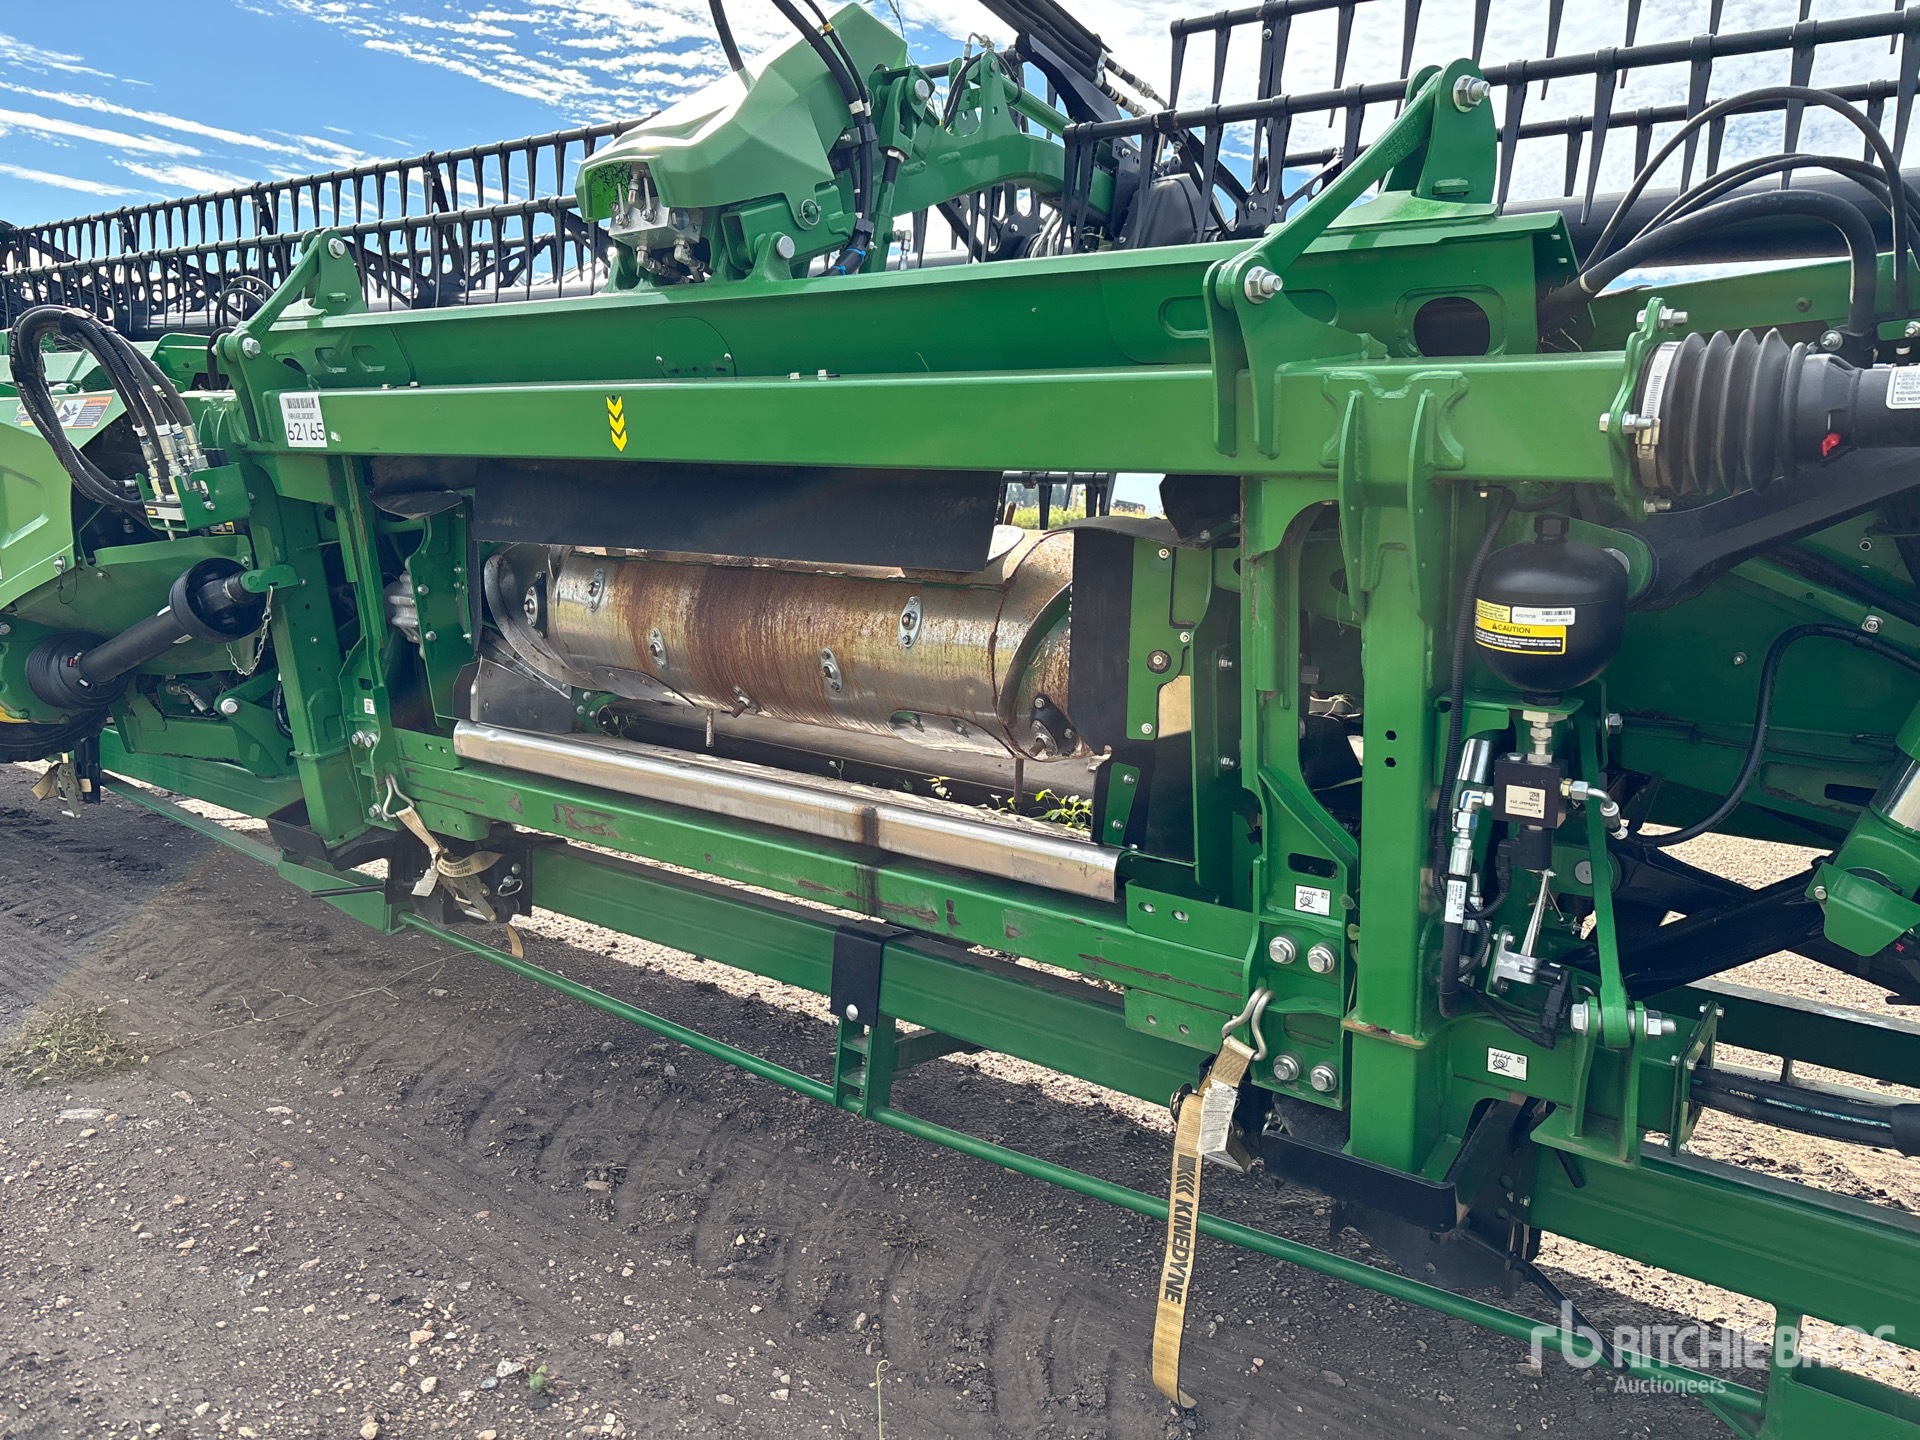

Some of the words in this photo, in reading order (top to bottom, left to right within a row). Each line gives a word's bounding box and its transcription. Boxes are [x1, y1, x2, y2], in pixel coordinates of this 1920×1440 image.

[287, 422, 326, 441] 62165
[1497, 625, 1531, 634] CAUTION
[1164, 1199, 1194, 1305] KINEDYNE
